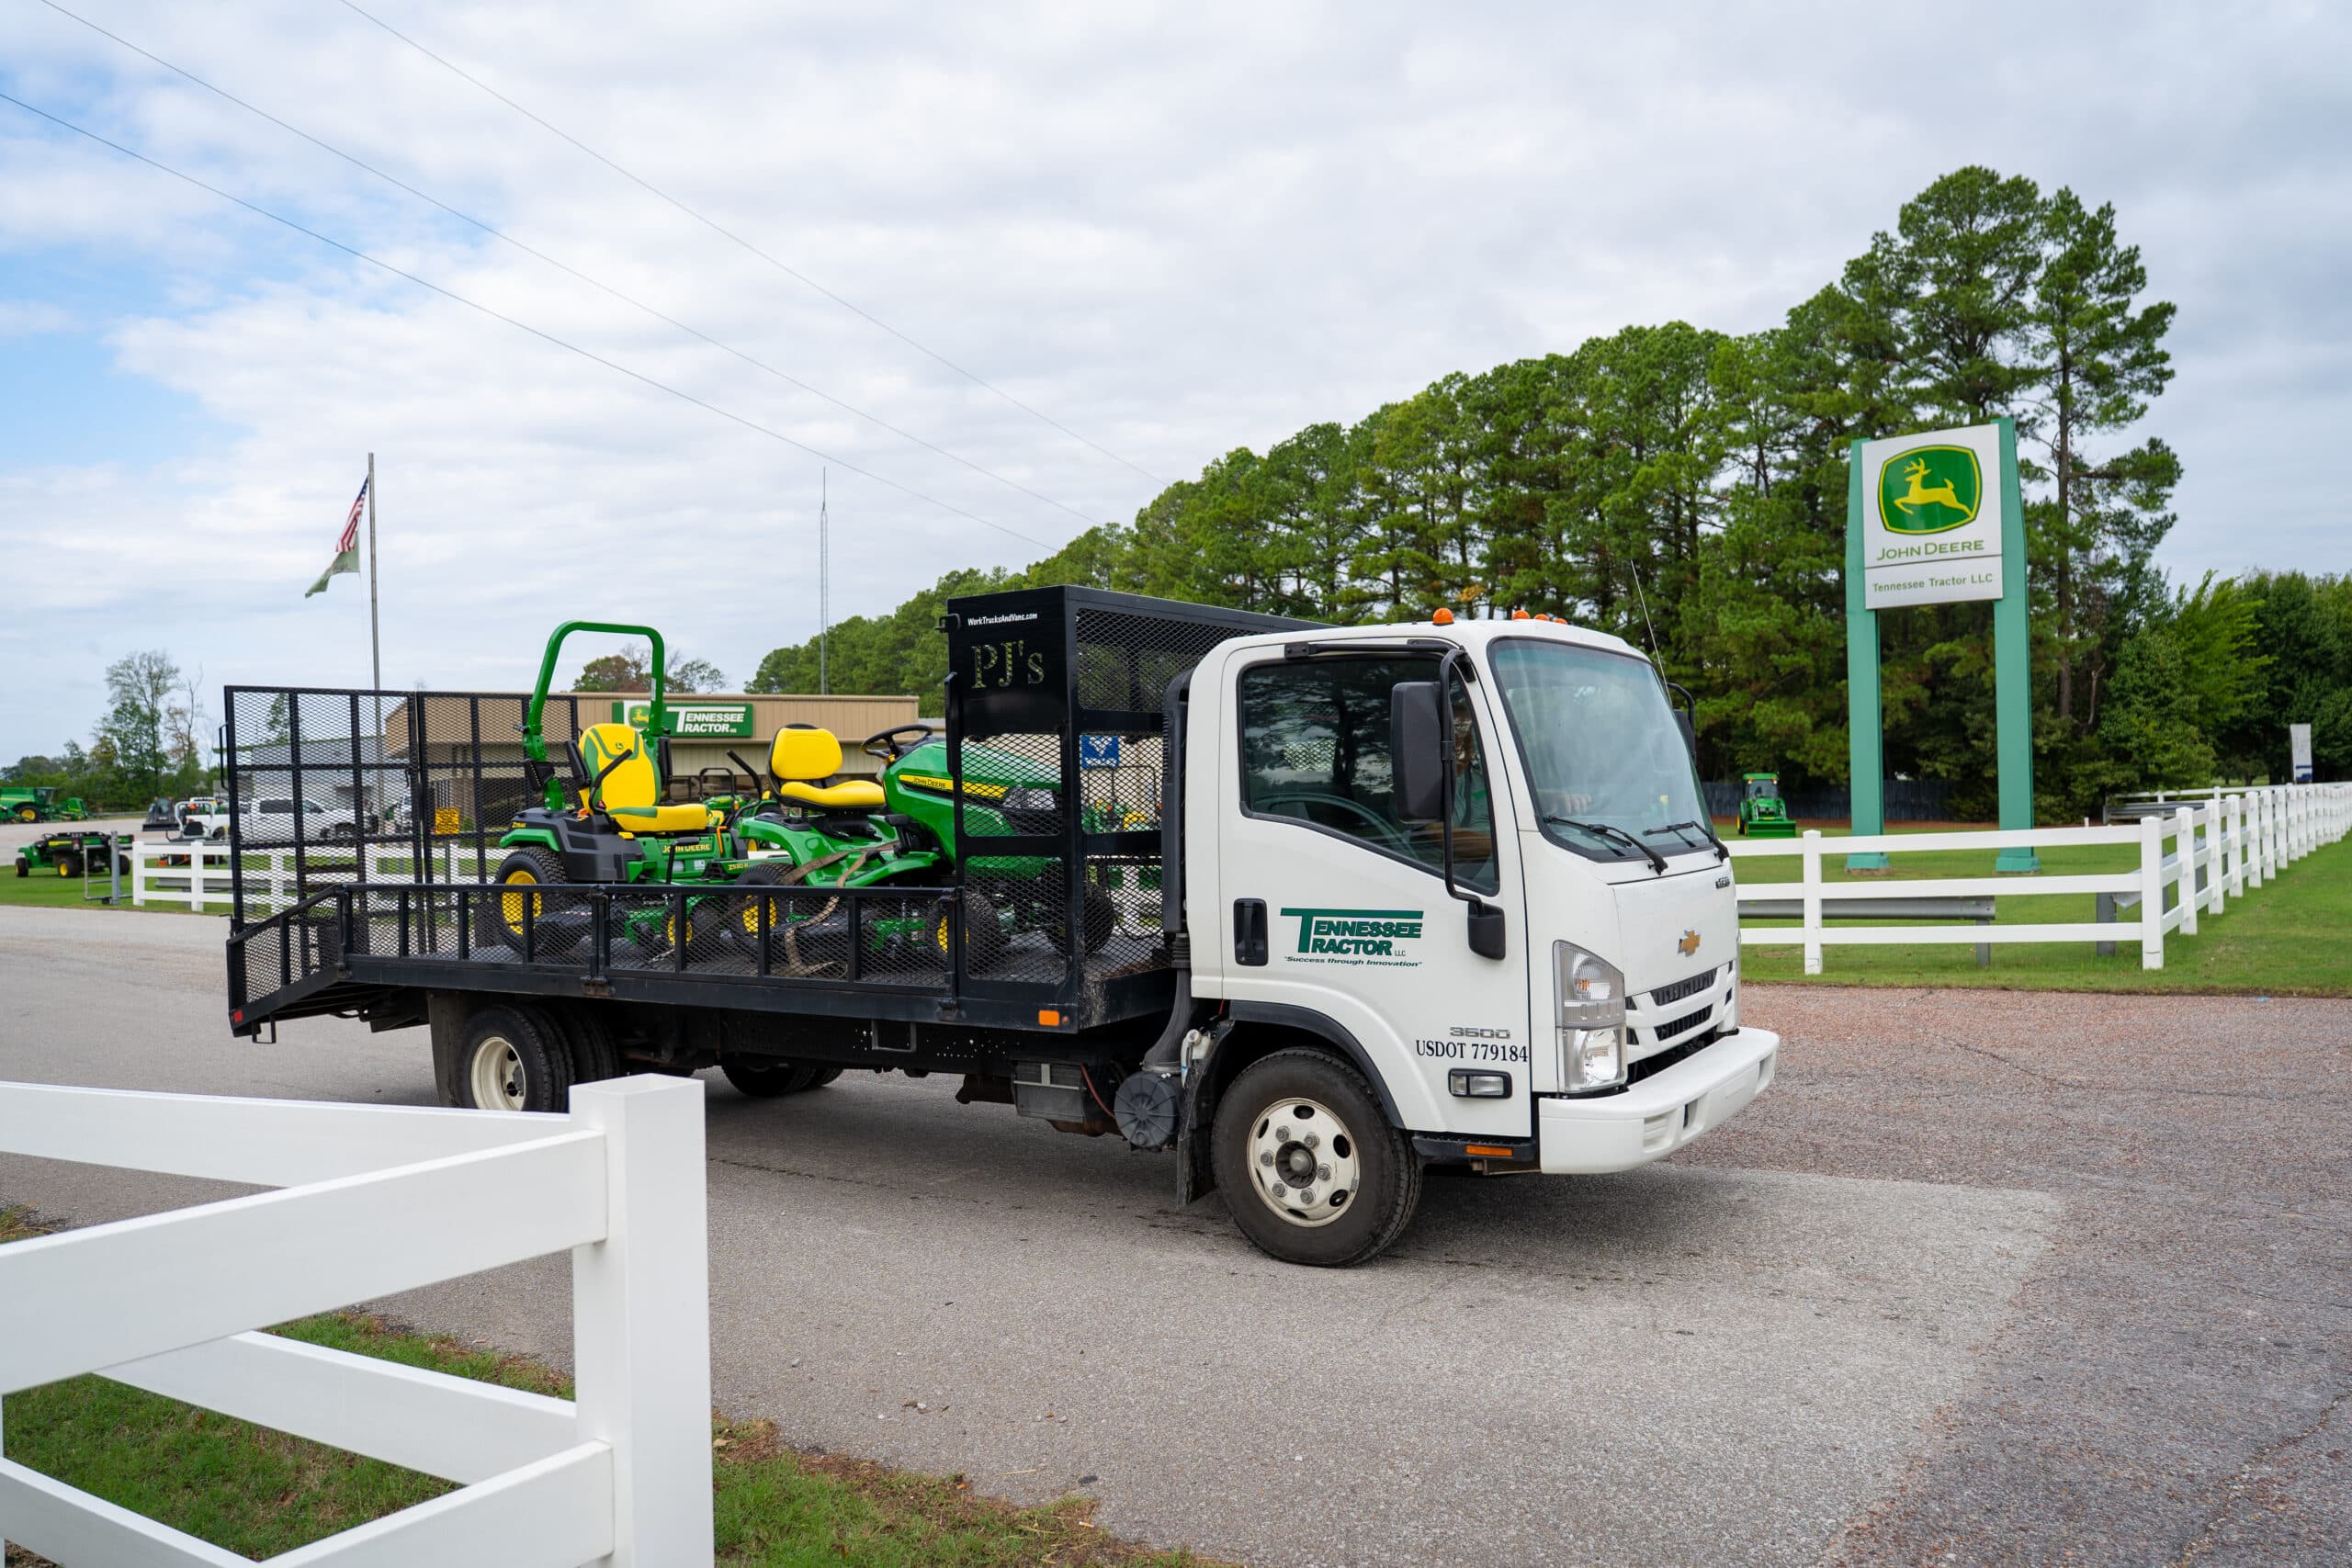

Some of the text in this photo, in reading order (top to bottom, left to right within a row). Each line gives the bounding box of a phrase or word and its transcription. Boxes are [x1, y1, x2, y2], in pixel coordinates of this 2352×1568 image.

[1876, 540, 1985, 561] JOHN DEERE
[1873, 573, 1993, 592] Tennessee Tractor LLC
[967, 613, 1038, 626] WorkTrucksAndVans.com
[971, 640, 1045, 689] PJ's
[666, 706, 746, 723] TENNESSEE
[676, 723, 729, 733] TRACTOR
[927, 779, 947, 789] DEERE
[684, 843, 711, 853] DEERE
[1281, 908, 1424, 939] TENNESSEE
[1298, 937, 1393, 956] TRACTOR
[1328, 958, 1364, 966] through
[1416, 1040, 1528, 1063] USDOT 779184
